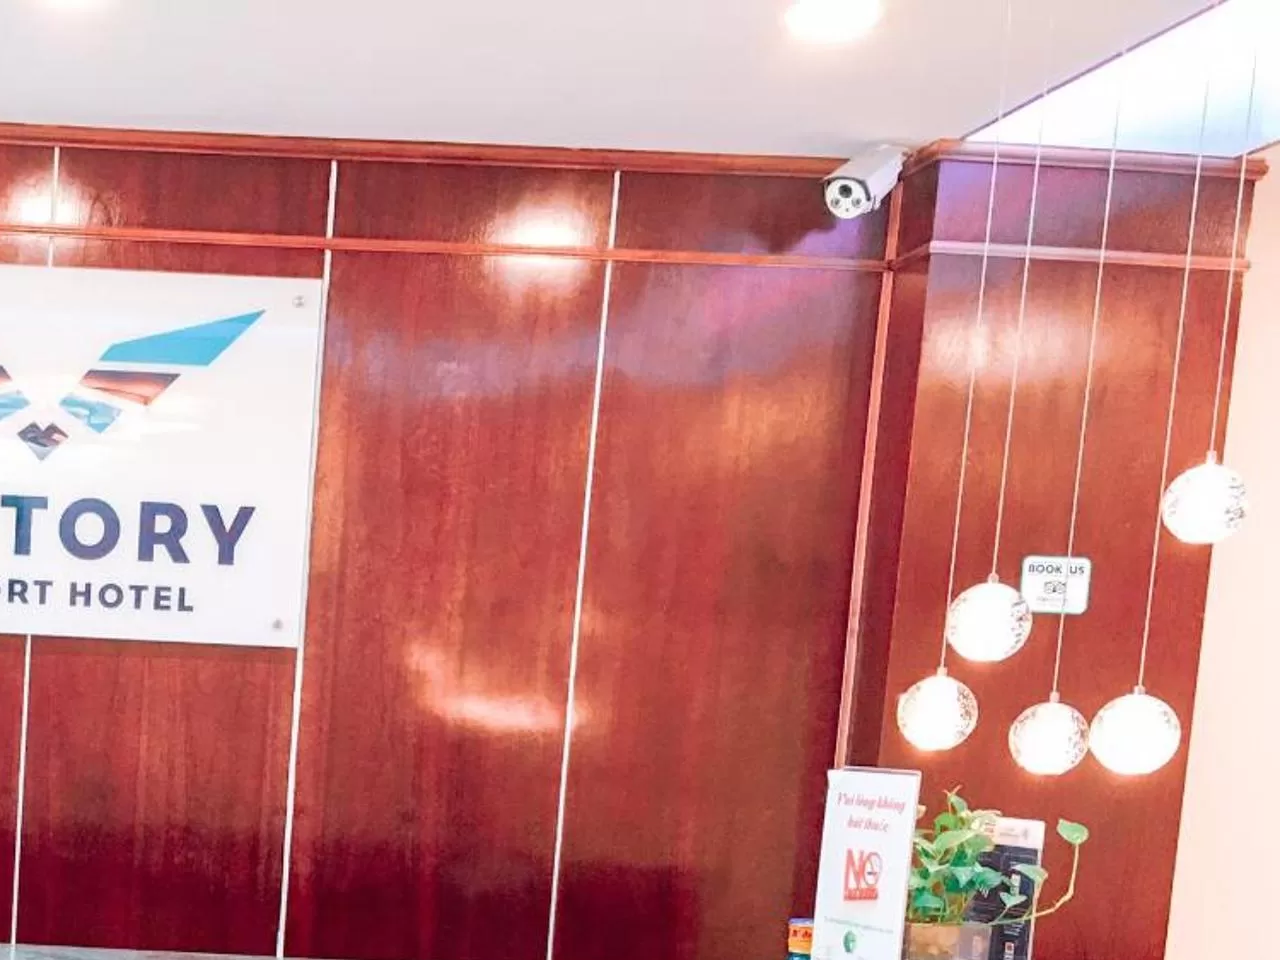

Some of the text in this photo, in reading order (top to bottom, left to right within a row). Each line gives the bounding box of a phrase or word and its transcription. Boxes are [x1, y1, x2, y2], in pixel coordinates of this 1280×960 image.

[1028, 563, 1085, 575] BOOK US
[69, 582, 194, 612] HOTEL
